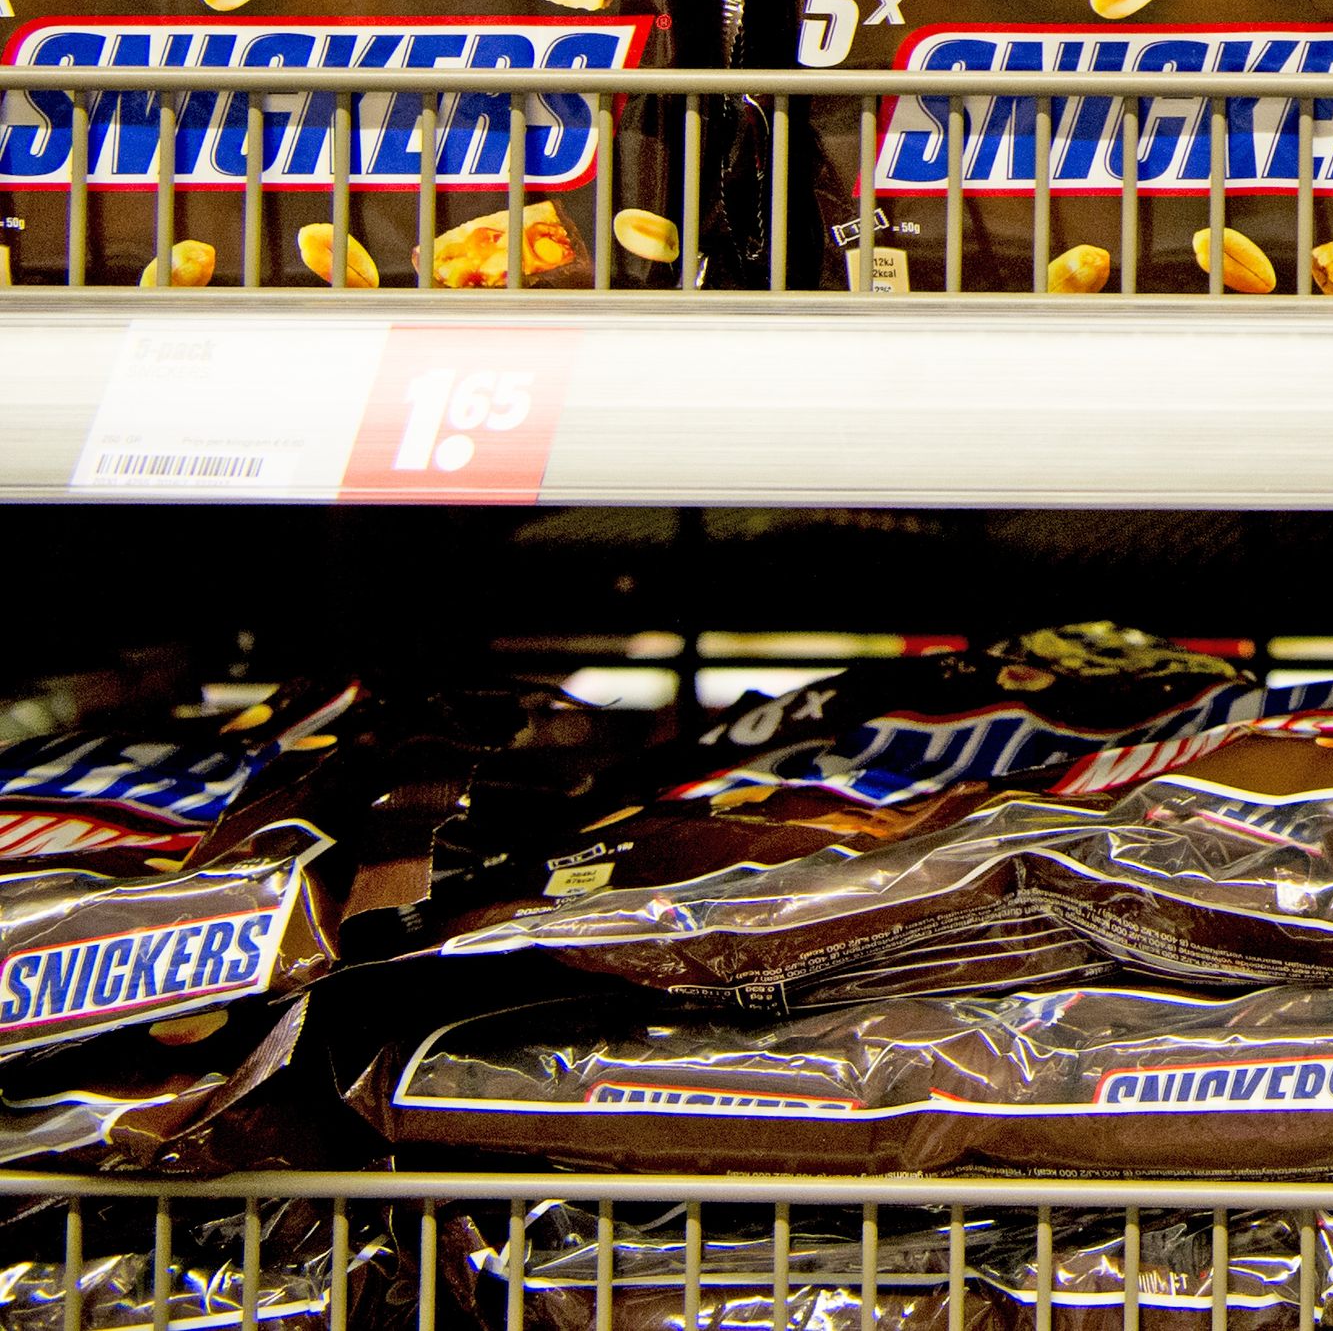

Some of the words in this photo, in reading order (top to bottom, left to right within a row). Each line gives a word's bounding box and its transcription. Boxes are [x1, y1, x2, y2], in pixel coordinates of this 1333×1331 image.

[0, 32, 622, 176] SNICKERS
[901, 222, 920, 234] 50g
[133, 337, 216, 362] 5-pack
[394, 367, 538, 472] 1.65
[0, 910, 274, 1026] SNICKERS
